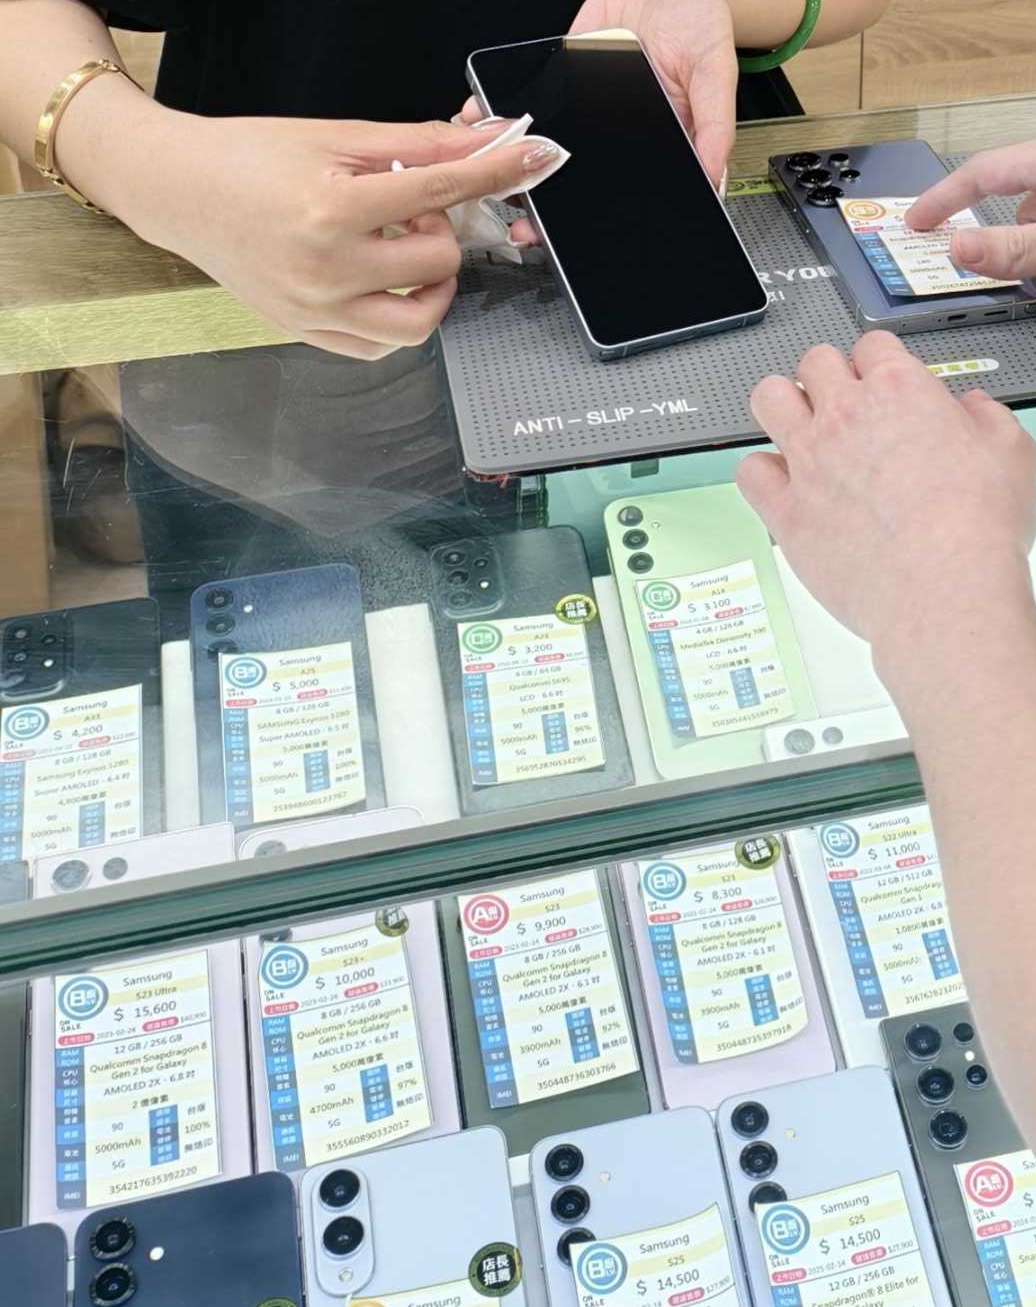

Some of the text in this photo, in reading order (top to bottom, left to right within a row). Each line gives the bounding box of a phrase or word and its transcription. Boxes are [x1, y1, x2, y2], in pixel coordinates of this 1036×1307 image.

[513, 416, 563, 435] ANTI
[586, 407, 634, 425] SLIP
[690, 574, 728, 588] Samsung
[514, 621, 554, 632] Samsung
[525, 643, 553, 655] 3,200
[280, 654, 322, 666] Samsung
[290, 679, 319, 691] 5,000
[64, 700, 108, 714] Samsung
[72, 725, 103, 738] 4,200
[868, 815, 910, 831] Samsung
[868, 841, 920, 861] $ 11,000
[697, 858, 741, 873] Samsung
[520, 886, 566, 903] Samsung
[694, 886, 742, 904] $ 8,300
[545, 903, 560, 912] S23
[517, 916, 567, 936] $ 9,900
[320, 938, 368, 957] Samsung
[532, 952, 544, 963] GB
[552, 947, 567, 959] 256
[568, 944, 581, 956] GB
[503, 966, 549, 983] Qualcomm
[550, 953, 601, 973] Snapdragon
[696, 952, 733, 967] AMOLED
[123, 969, 173, 988] Samsung
[315, 967, 375, 990] $ 10,000
[523, 966, 591, 988] Gen 2 for Galaxy
[135, 985, 177, 1000] S23 Ultra
[518, 987, 557, 1002] AMOLED
[113, 1000, 177, 1023] $ 15,600
[328, 1007, 343, 1019] GB
[350, 1002, 367, 1015] 256
[368, 998, 381, 1010] GB
[297, 1022, 346, 1041] Qualcomm
[346, 1007, 401, 1028] Snapdragon
[532, 1024, 543, 1033] 90
[318, 1022, 391, 1046] Gen 2 for Galaxy
[114, 1034, 182, 1055] 12 GB 256 GB
[312, 1040, 367, 1061] AMOLED 2X
[520, 1037, 561, 1055] 3900mAh
[89, 1058, 142, 1074] Qualcomm
[143, 1044, 200, 1064] Snapdragon
[537, 1058, 550, 1068] 5G
[111, 1058, 187, 1081] Gen 2 for Galaxy
[104, 1078, 161, 1097] AMOLED 2X
[324, 1083, 336, 1094] 90
[309, 1096, 354, 1115] 4700mAh
[112, 1122, 123, 1132] 90
[328, 1118, 341, 1128] 5G
[95, 1137, 141, 1154] 5000mAh
[112, 1159, 125, 1170] 5G
[821, 1194, 870, 1215] Samsung
[1023, 1192, 1034, 1207] $
[849, 1214, 866, 1226] S25
[639, 1233, 690, 1254] Samsung
[819, 1228, 881, 1255] $ 14,500
[481, 1254, 510, 1272] 店長
[668, 1254, 686, 1267] S25
[636, 1268, 700, 1296] $ 14,500
[829, 1265, 895, 1292] 12 GB 256 GB
[877, 1284, 884, 1295] 8
[885, 1279, 904, 1292] Elite
[906, 1276, 919, 1288] for
